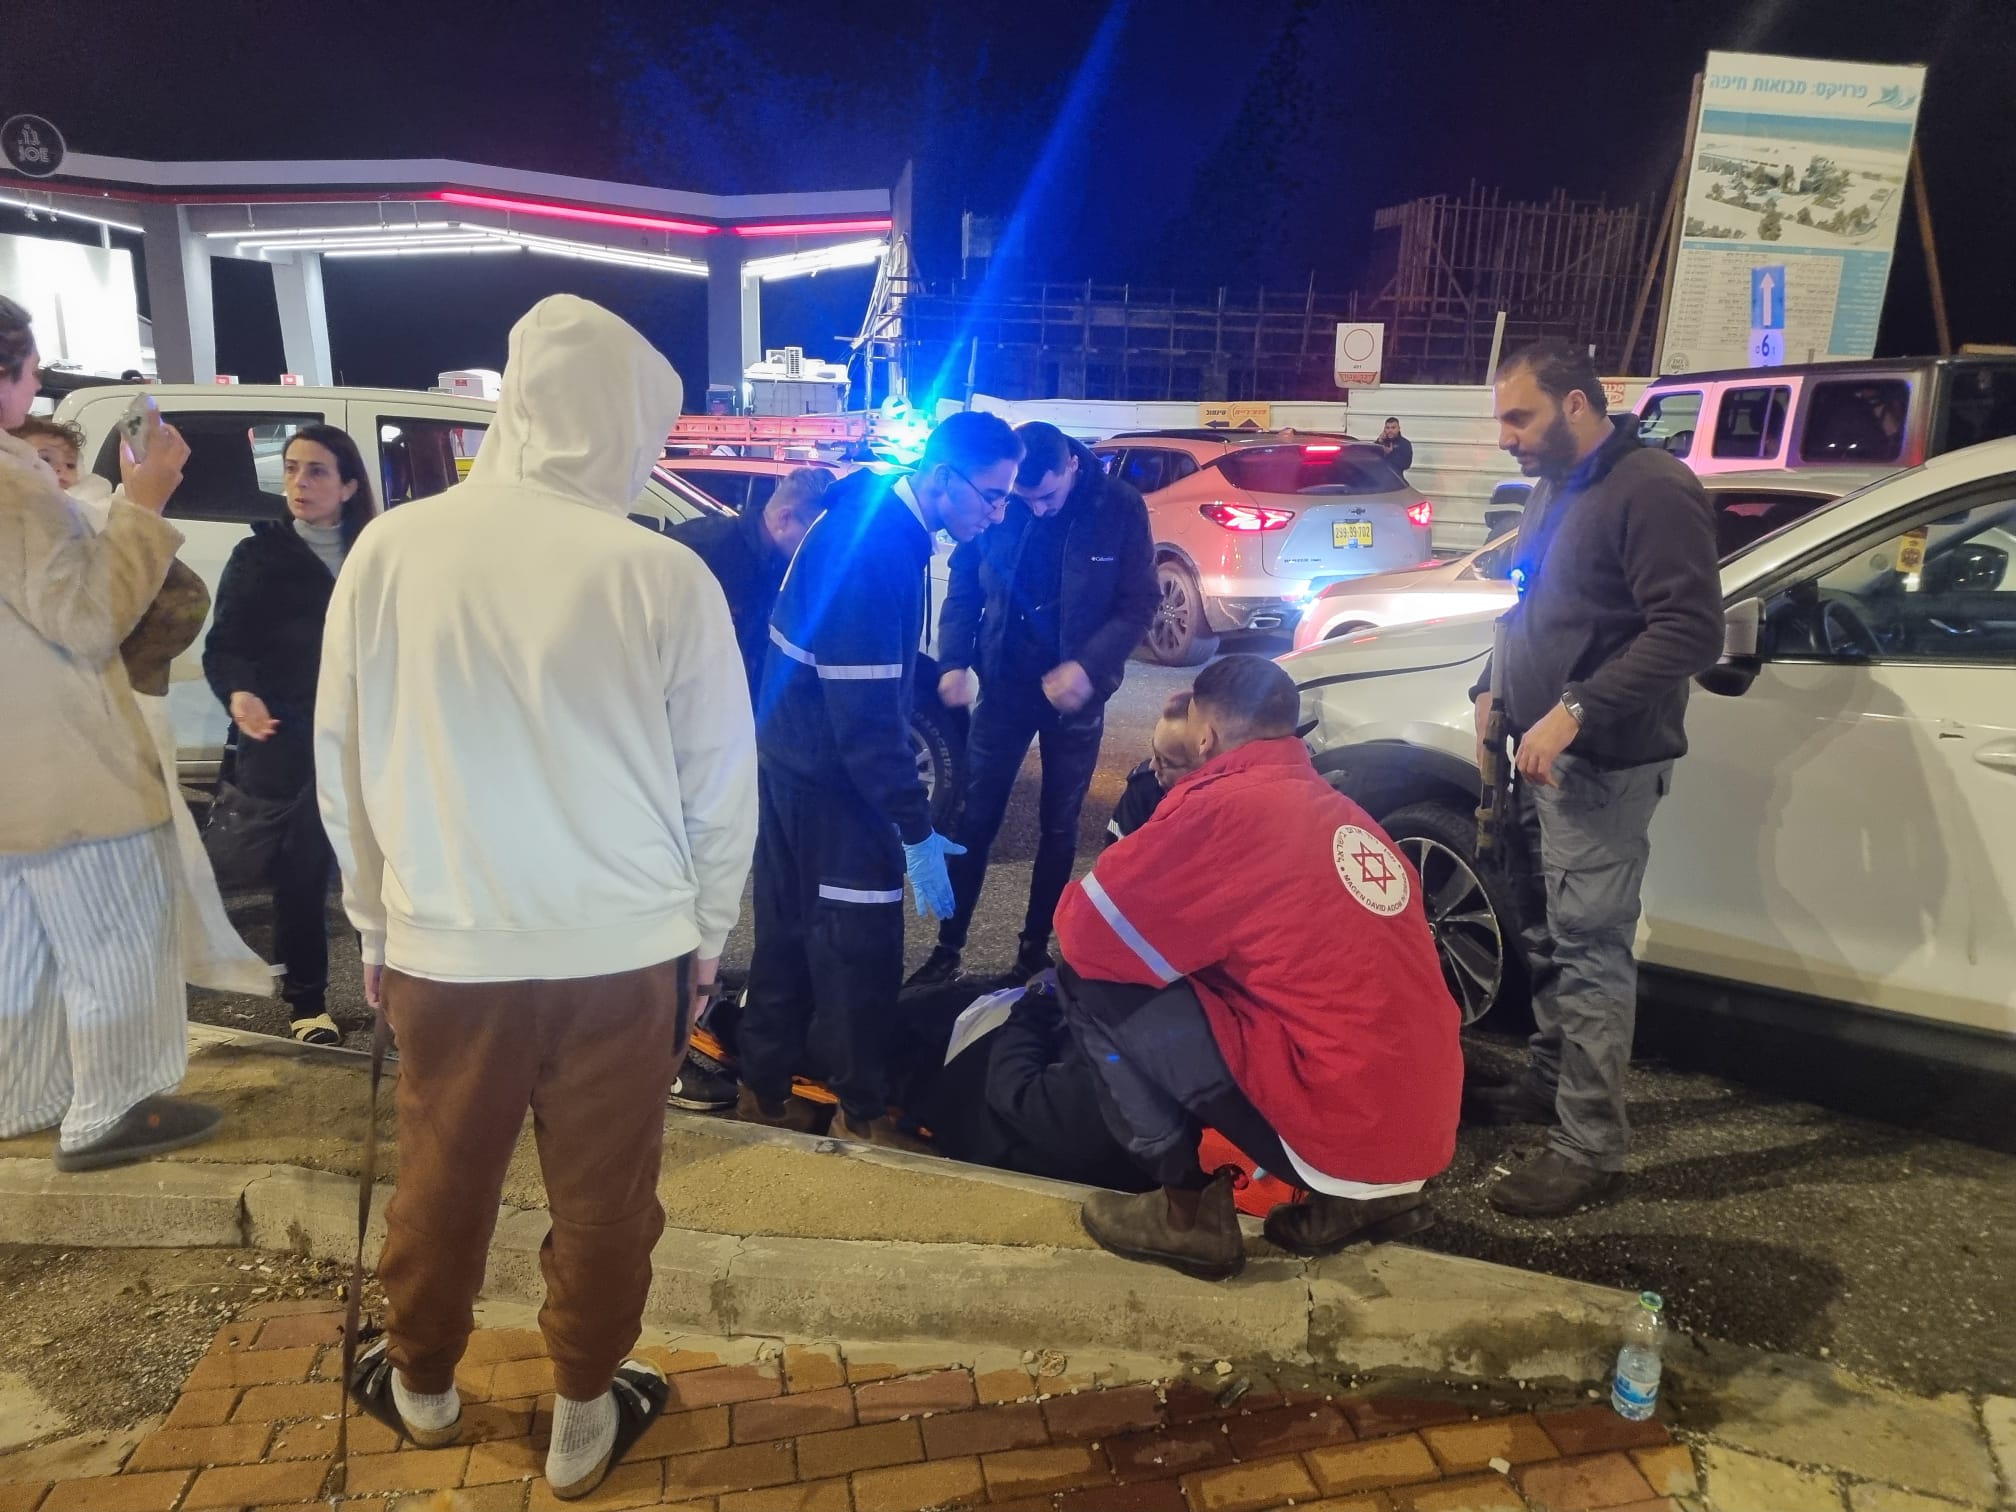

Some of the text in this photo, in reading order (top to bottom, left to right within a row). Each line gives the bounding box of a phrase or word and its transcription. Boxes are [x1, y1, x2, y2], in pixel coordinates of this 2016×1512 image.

[1709, 74, 1747, 91] חיפה
[1752, 78, 1807, 95] מבואות
[1343, 874, 1366, 901] MAGEN
[1366, 898, 1386, 912] DAVID
